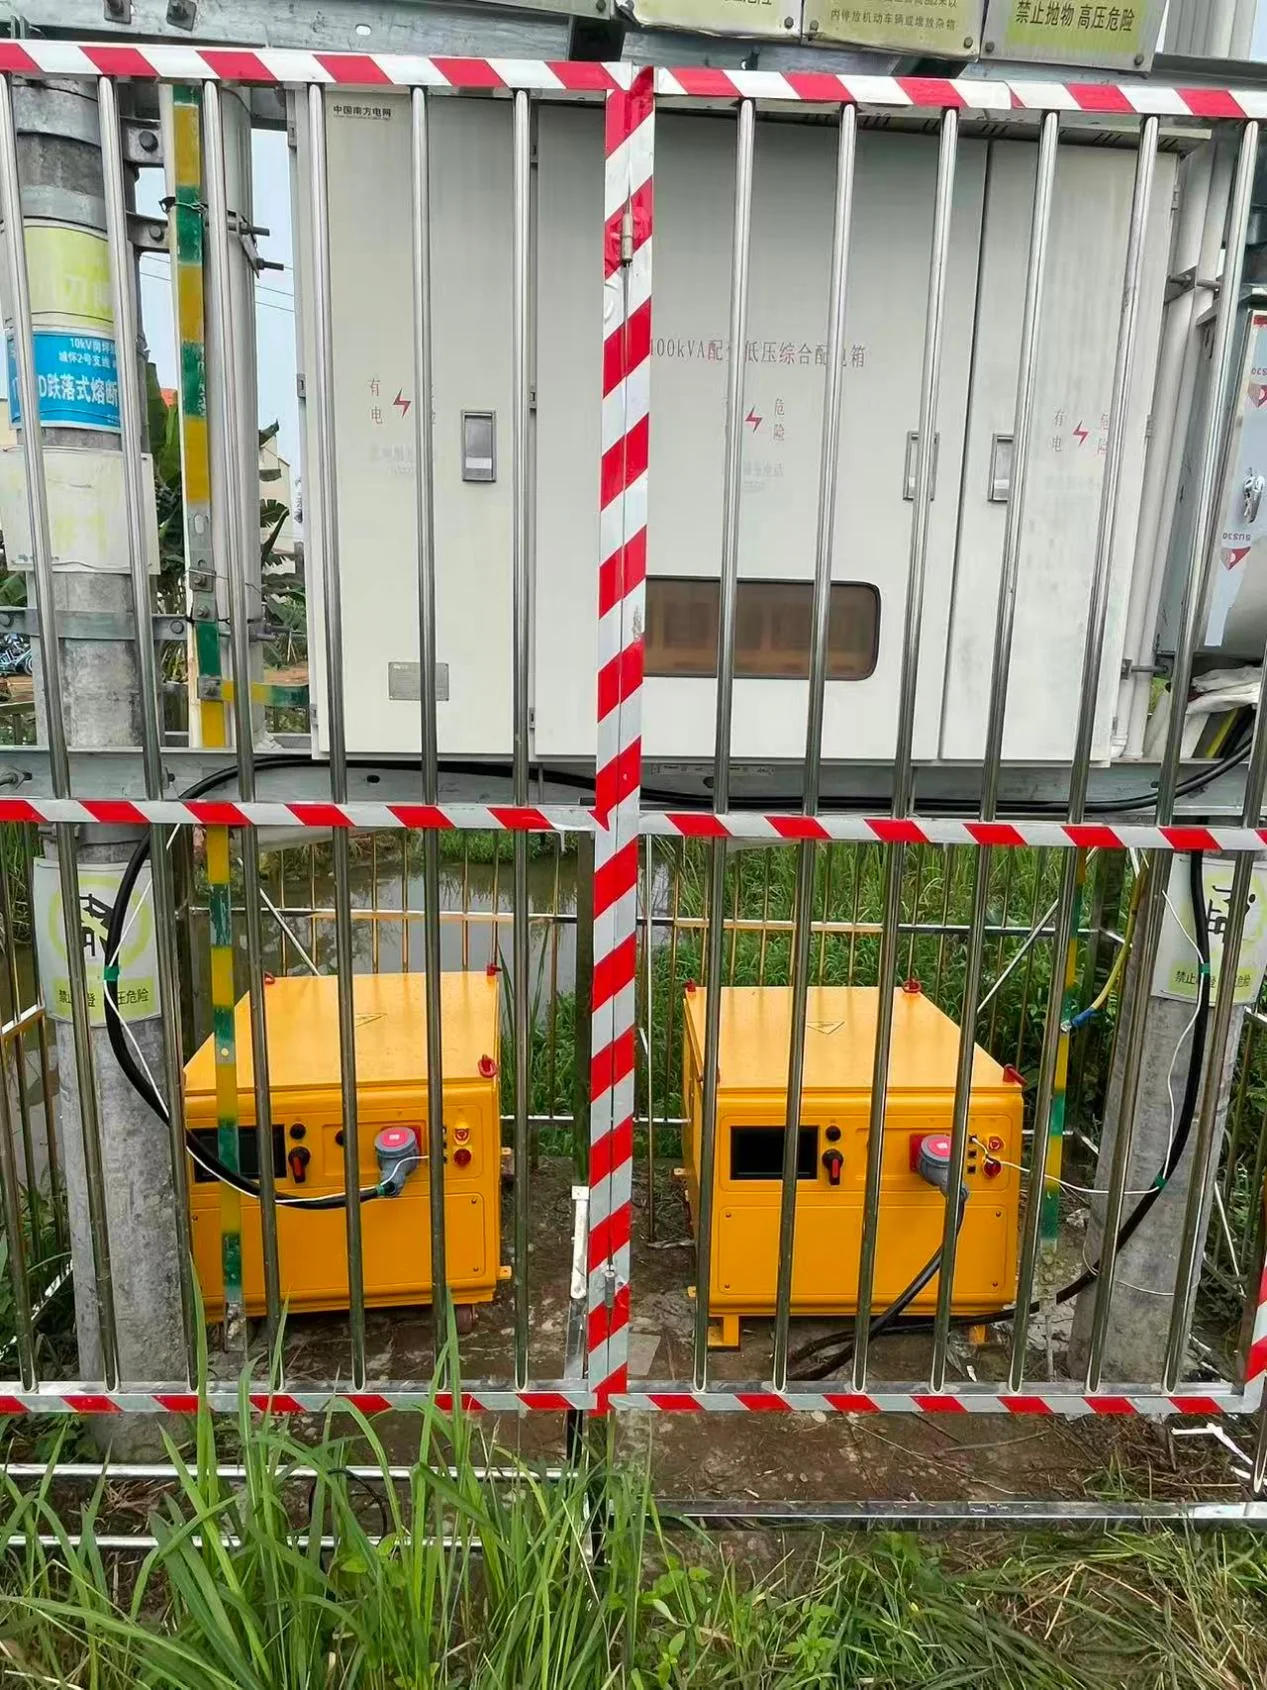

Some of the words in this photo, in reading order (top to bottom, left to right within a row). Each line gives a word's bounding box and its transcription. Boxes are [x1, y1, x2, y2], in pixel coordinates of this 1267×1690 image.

[1016, 0, 1074, 26] 禁止抛物
[1078, 4, 1135, 31] 高压危险
[333, 105, 392, 117] 中国南方电网
